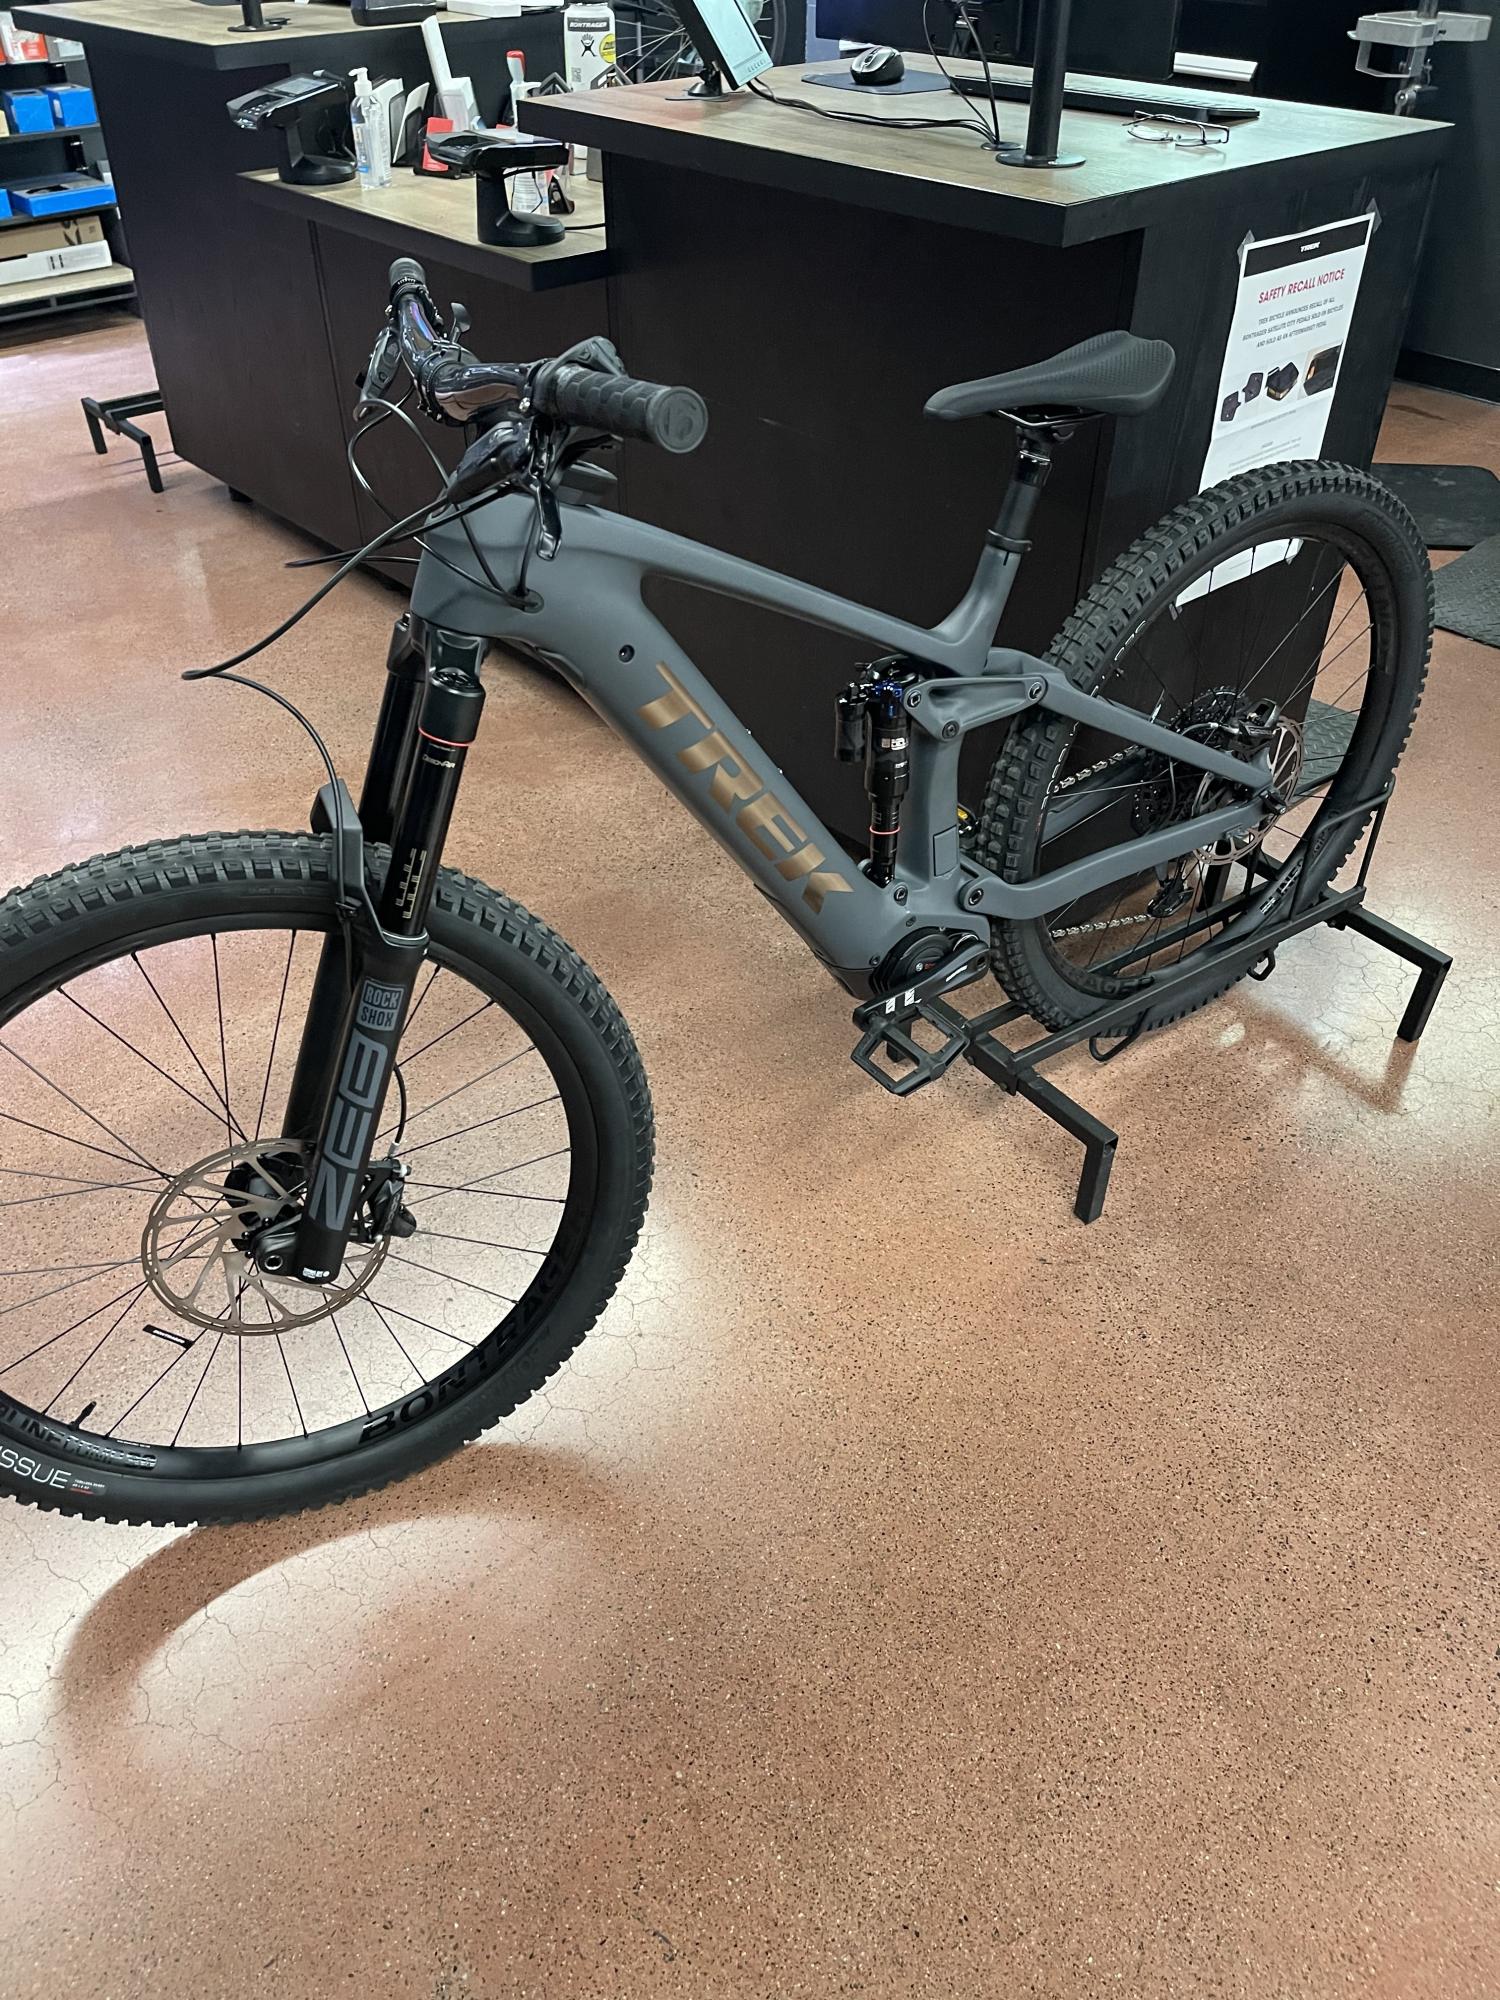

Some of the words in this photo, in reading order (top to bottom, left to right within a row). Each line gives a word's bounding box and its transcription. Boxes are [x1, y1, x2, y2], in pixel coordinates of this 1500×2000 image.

[1301, 242, 1320, 252] TREK
[1259, 286, 1286, 303] SAFETY
[1288, 278, 1315, 295] RECALL
[1318, 269, 1345, 286] NOTICE
[634, 660, 855, 915] TREK
[360, 1004, 397, 1029] SHOX
[363, 984, 401, 1010] ROCK
[308, 1028, 389, 1232] ZEB
[358, 1215, 582, 1445] BONTRAG
[0, 1445, 72, 1489] SSUE
